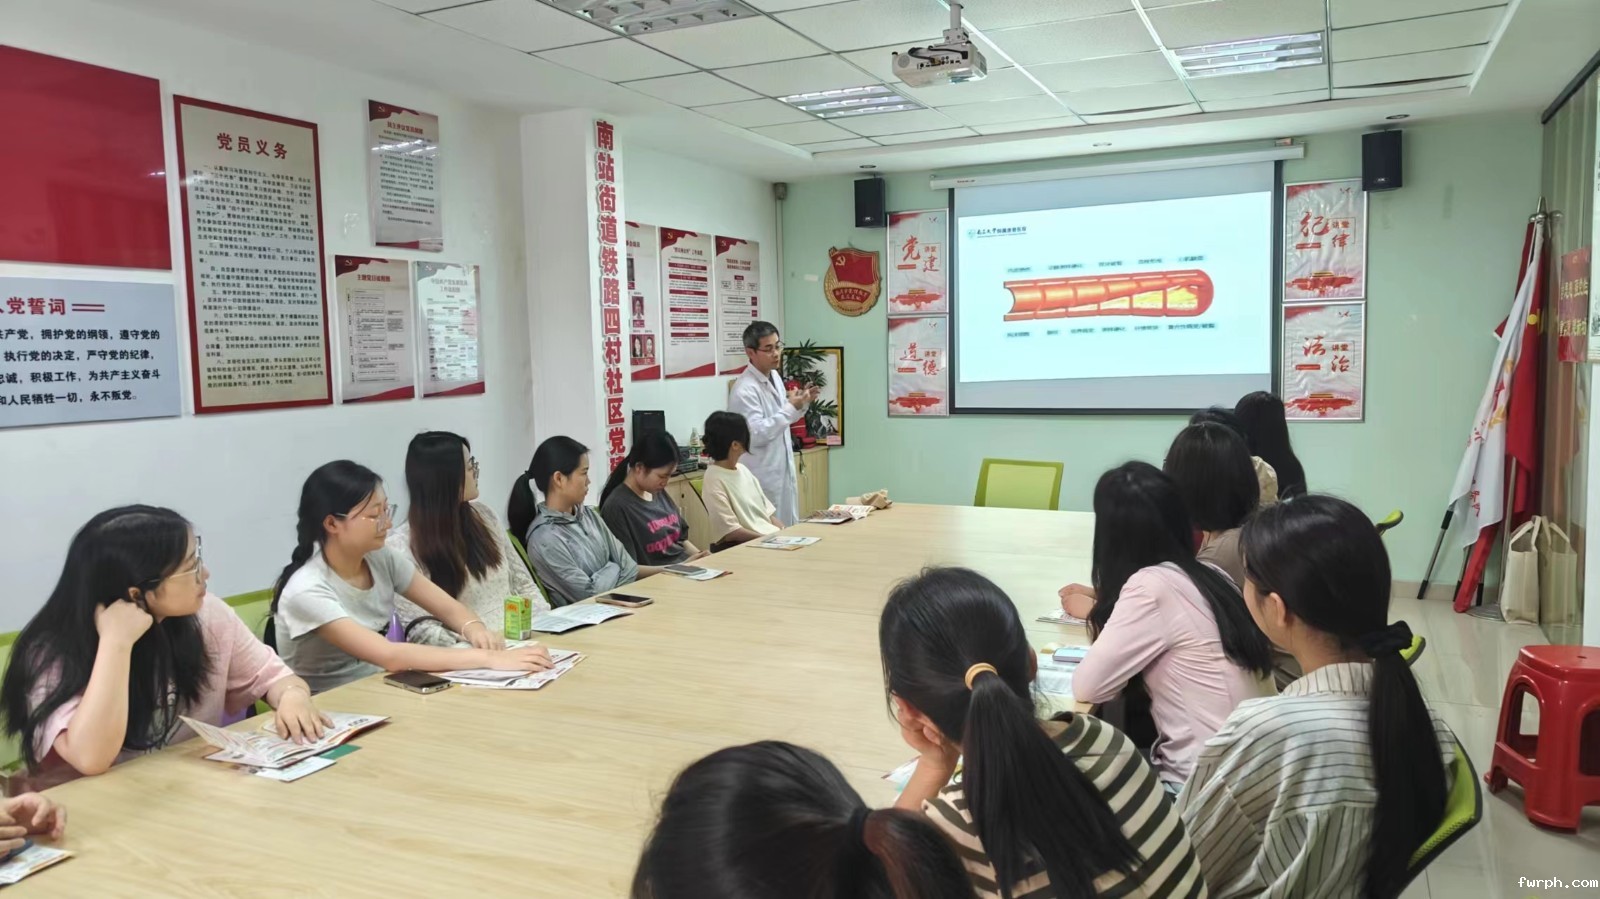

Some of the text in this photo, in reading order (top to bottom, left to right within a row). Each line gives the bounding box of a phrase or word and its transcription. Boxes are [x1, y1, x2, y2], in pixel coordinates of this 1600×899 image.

[216, 132, 288, 160] 党员义务
[0, 297, 66, 315] 党誓词
